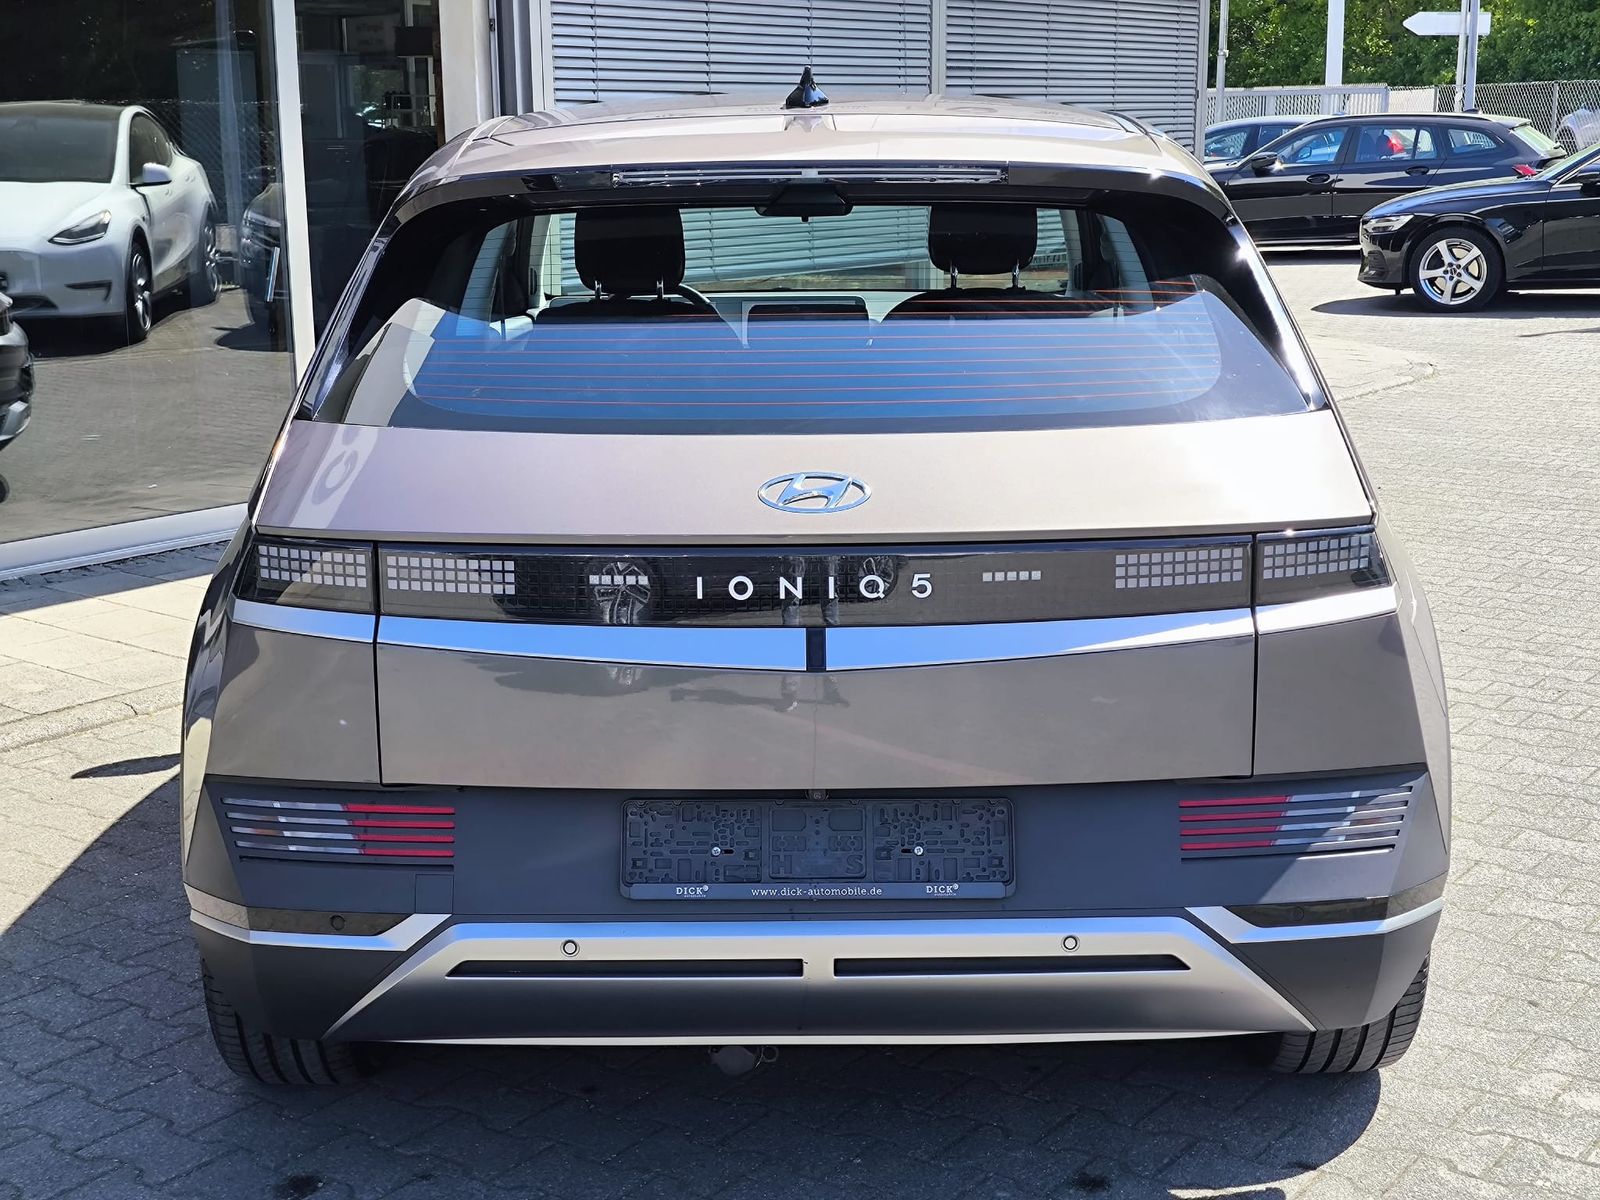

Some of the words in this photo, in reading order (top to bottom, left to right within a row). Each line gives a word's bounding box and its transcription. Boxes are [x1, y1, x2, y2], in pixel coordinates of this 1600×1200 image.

[696, 574, 885, 601] IONIQ
[911, 573, 933, 599] 5
[676, 886, 703, 895] DICK
[751, 886, 883, 897] www.dick-automobile.de
[926, 885, 953, 894] DICK
